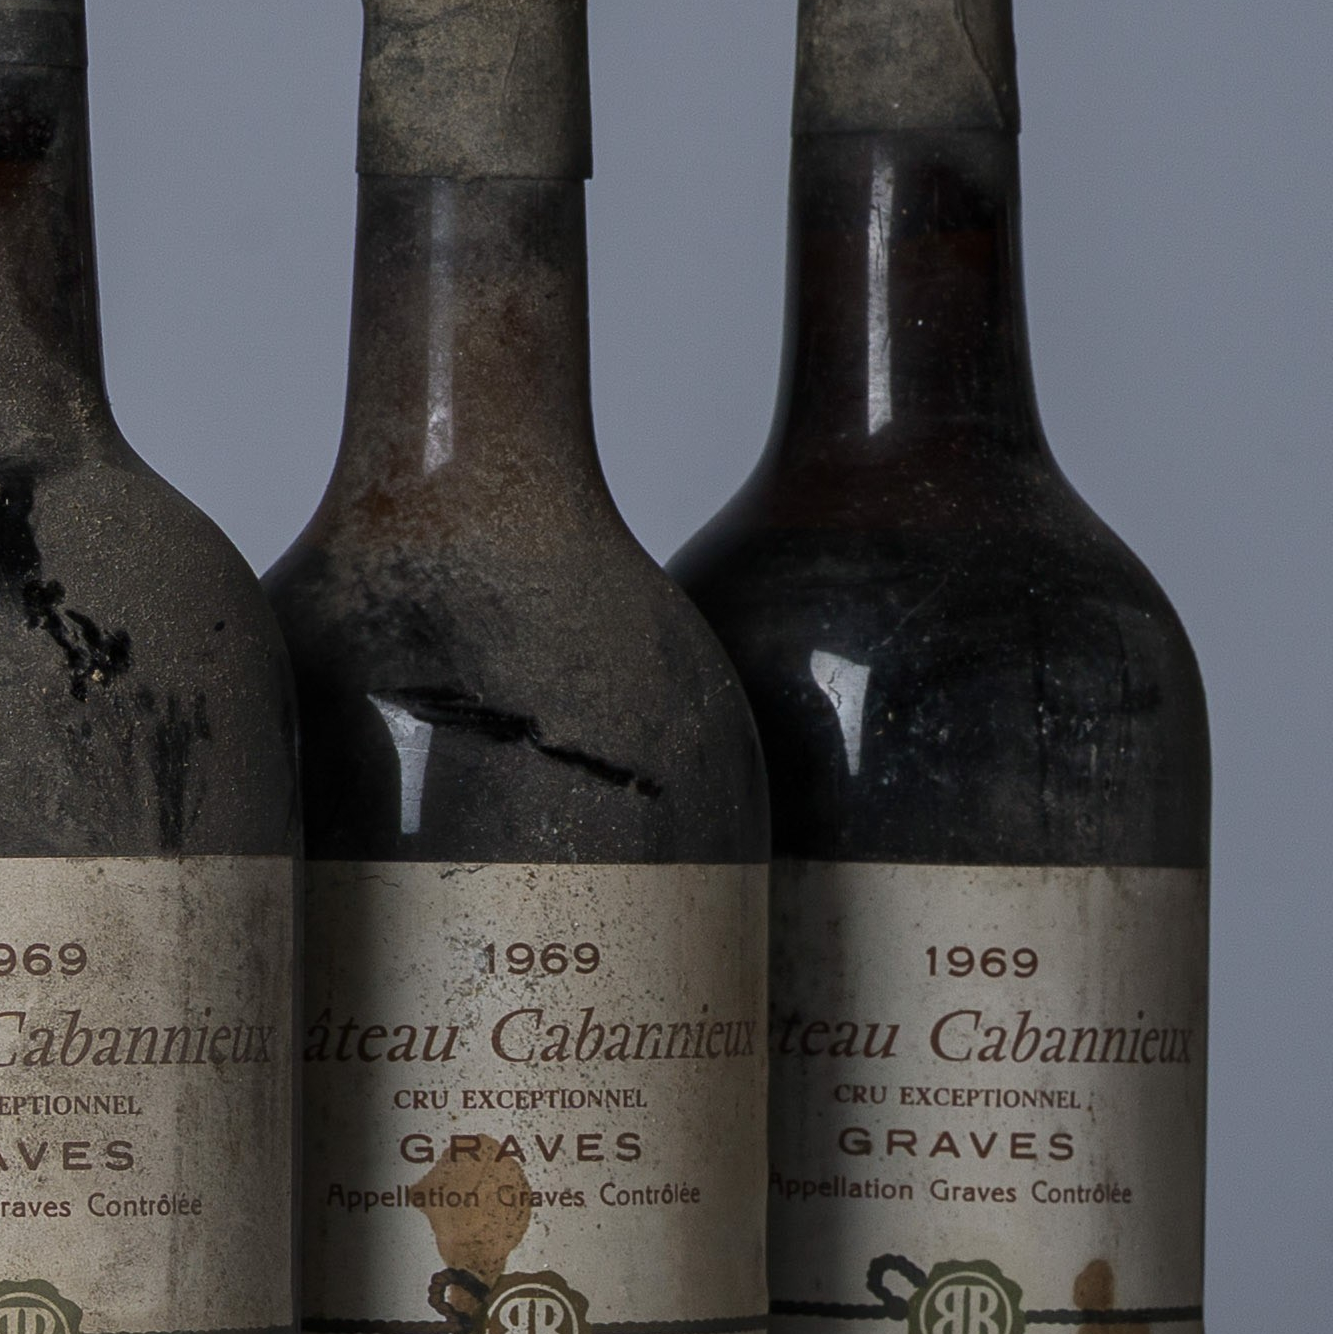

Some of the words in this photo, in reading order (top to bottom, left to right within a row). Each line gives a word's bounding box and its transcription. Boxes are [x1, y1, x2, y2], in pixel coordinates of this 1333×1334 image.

[484, 942, 601, 975] 1969
[925, 945, 1039, 979] 1969
[303, 1007, 461, 1064] âteau
[490, 1002, 757, 1064] Cabannieux
[929, 1009, 1193, 1065] Cabannieux
[393, 1089, 449, 1110] CRU
[462, 1088, 647, 1110] EXCEPTIONNEL
[834, 1084, 887, 1105] CRU
[900, 1086, 1082, 1110] EXCEPTIONNEL
[399, 1132, 643, 1164] GRAVES
[838, 1126, 1075, 1162] GRAVES
[88, 1191, 203, 1218] Contrôlée
[327, 1182, 480, 1212] Appellation
[496, 1183, 586, 1209] Graves
[599, 1180, 701, 1207] Contrôlée
[929, 1178, 1017, 1204] Graves
[1031, 1180, 1132, 1205] Contrôlée
